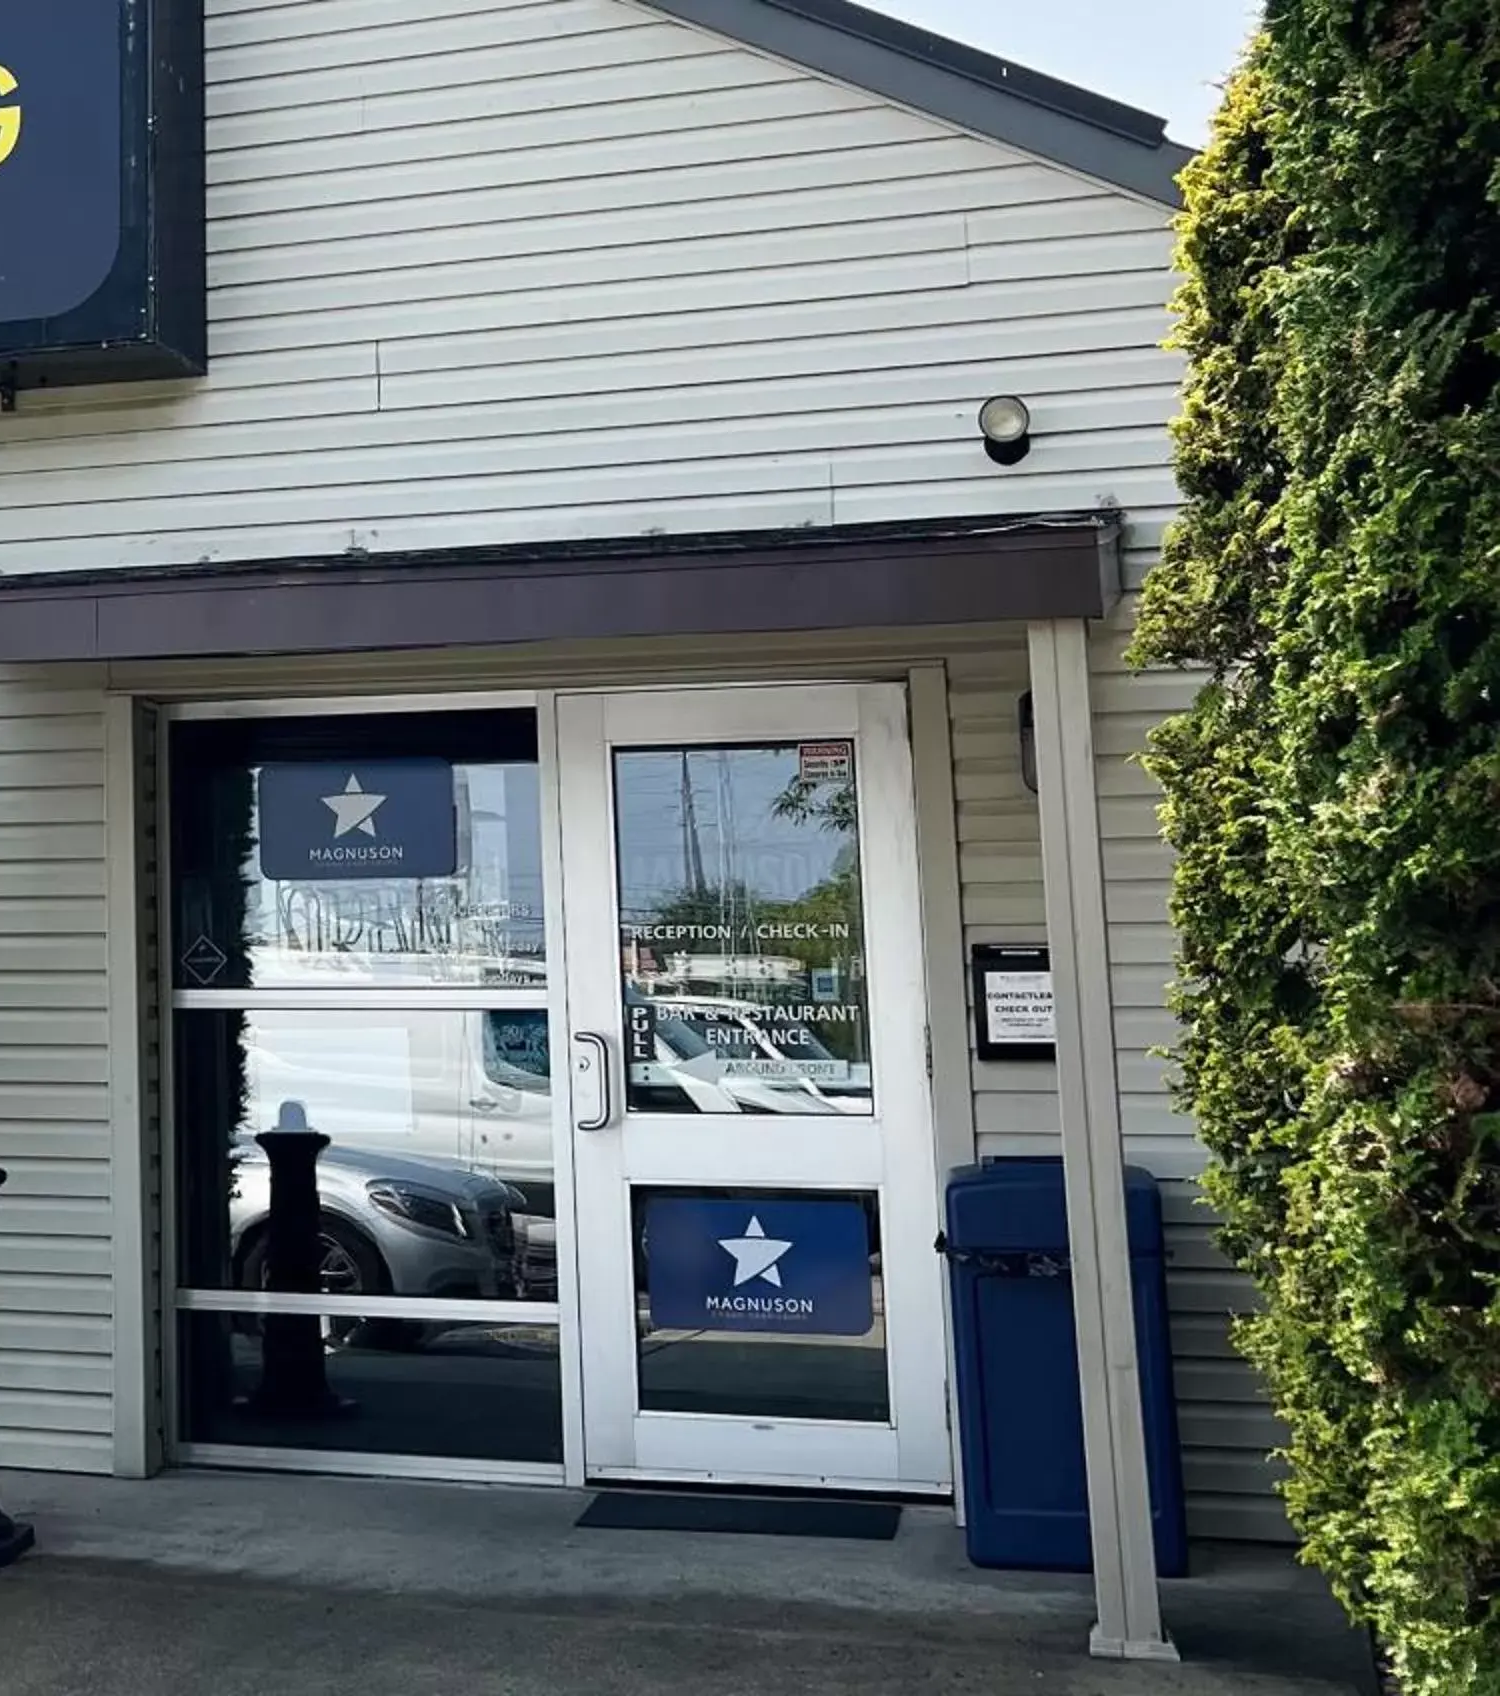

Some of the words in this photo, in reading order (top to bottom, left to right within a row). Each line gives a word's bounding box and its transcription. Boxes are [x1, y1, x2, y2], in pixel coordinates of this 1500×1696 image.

[308, 846, 404, 861] MAGNUSON
[631, 924, 731, 940] RECEPTION
[756, 923, 850, 939] CHECK-IN
[655, 1006, 696, 1021] BAR
[704, 1005, 720, 1021] &
[727, 1004, 859, 1022] RESTAURANT
[994, 1004, 1030, 1014] CHECK
[1031, 1004, 1054, 1014] OUT
[632, 1007, 649, 1058] PULL
[706, 1029, 810, 1046] ENTRANCE
[706, 1296, 814, 1313] MAGNUSON
